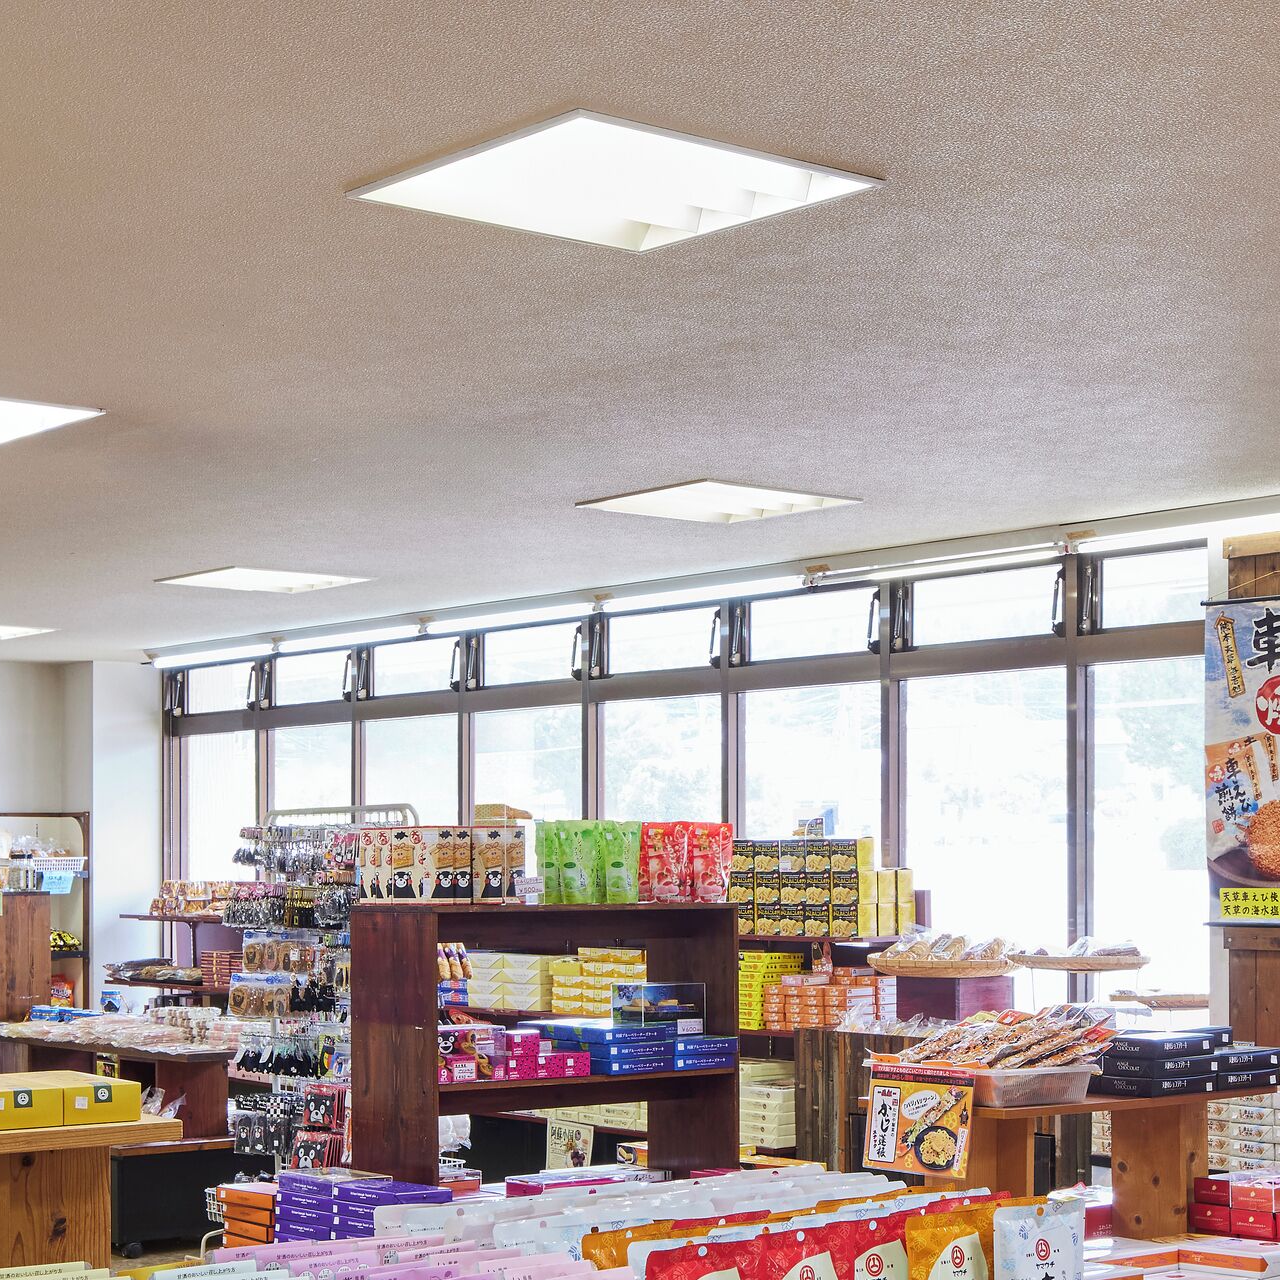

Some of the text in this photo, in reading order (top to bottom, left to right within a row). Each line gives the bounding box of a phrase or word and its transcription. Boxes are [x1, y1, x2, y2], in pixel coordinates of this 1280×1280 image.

[1035, 1262, 1055, 1270] ヤマウチ
[952, 1269, 968, 1277] ヤマウチ
